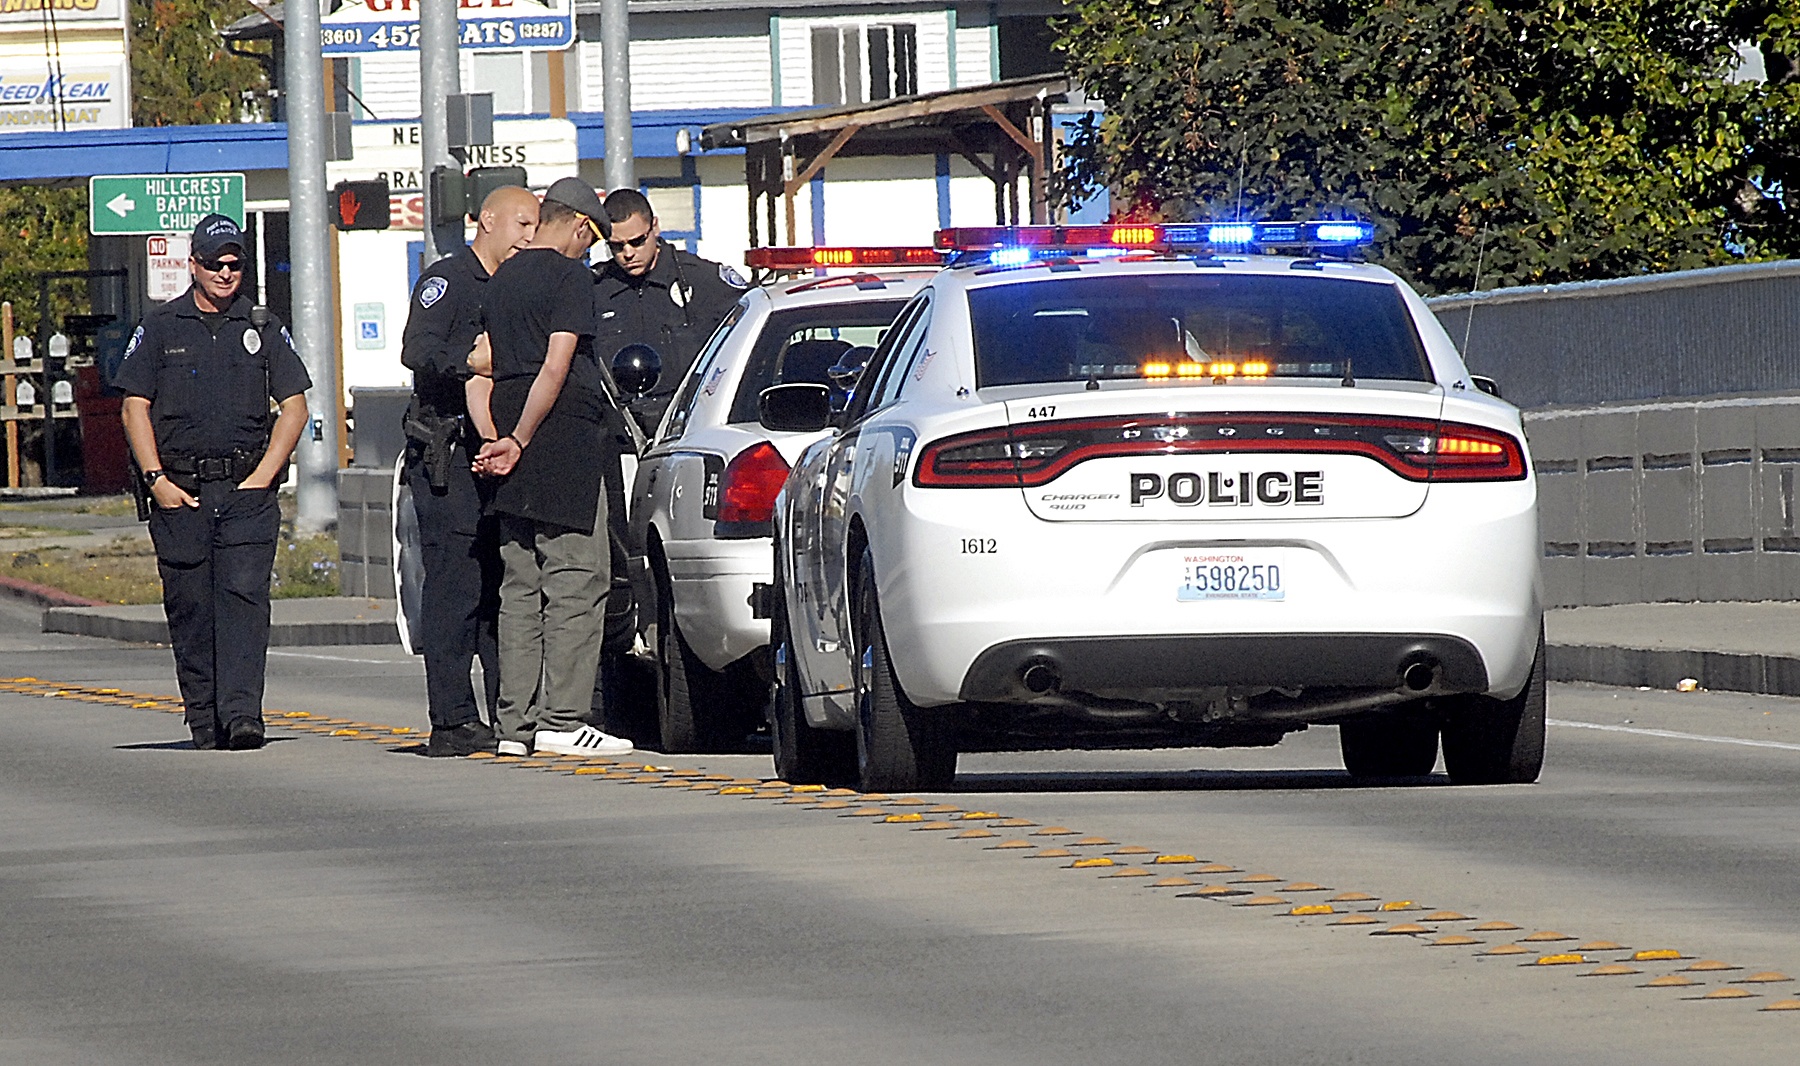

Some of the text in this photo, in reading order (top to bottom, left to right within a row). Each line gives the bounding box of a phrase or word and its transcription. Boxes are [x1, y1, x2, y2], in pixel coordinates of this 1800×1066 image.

[458, 21, 516, 44] ATS
[519, 21, 564, 38] (3287)
[0, 74, 110, 99] EEDKLEAN
[393, 127, 420, 144] NE
[465, 146, 526, 164] NNESS
[145, 179, 231, 195] HILLCREST
[378, 171, 422, 188] BRA
[156, 196, 221, 212] BAPTIST
[160, 212, 208, 229] CHUR
[150, 240, 166, 254] NO
[151, 258, 186, 269] PARKING
[1028, 406, 1056, 418] 447
[1129, 470, 1325, 508] POLICE
[961, 538, 998, 554] 1612
[1184, 555, 1244, 563] WASHINGTON
